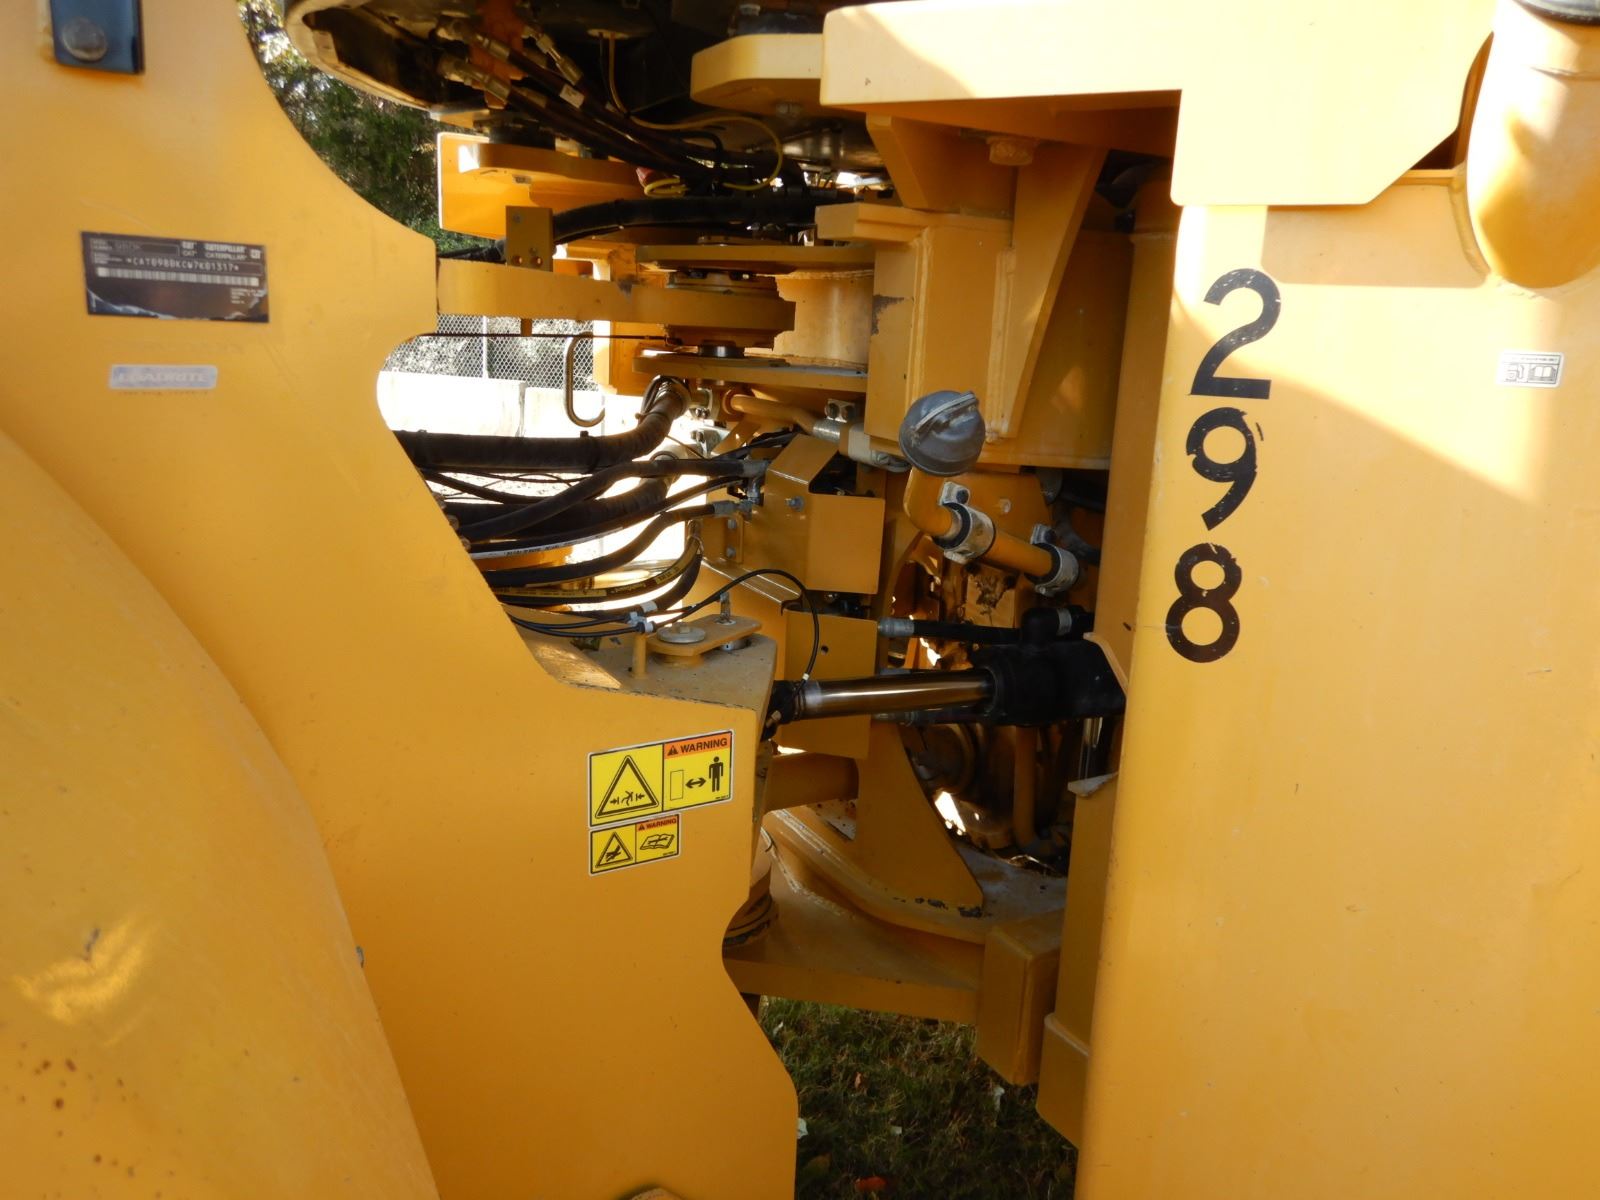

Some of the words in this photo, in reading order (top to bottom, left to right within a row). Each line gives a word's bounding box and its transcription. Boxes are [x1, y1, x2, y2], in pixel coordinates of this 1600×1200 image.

[1165, 268, 1282, 663] 298
[680, 738, 727, 754] WARNING
[646, 818, 677, 829] WARNING
